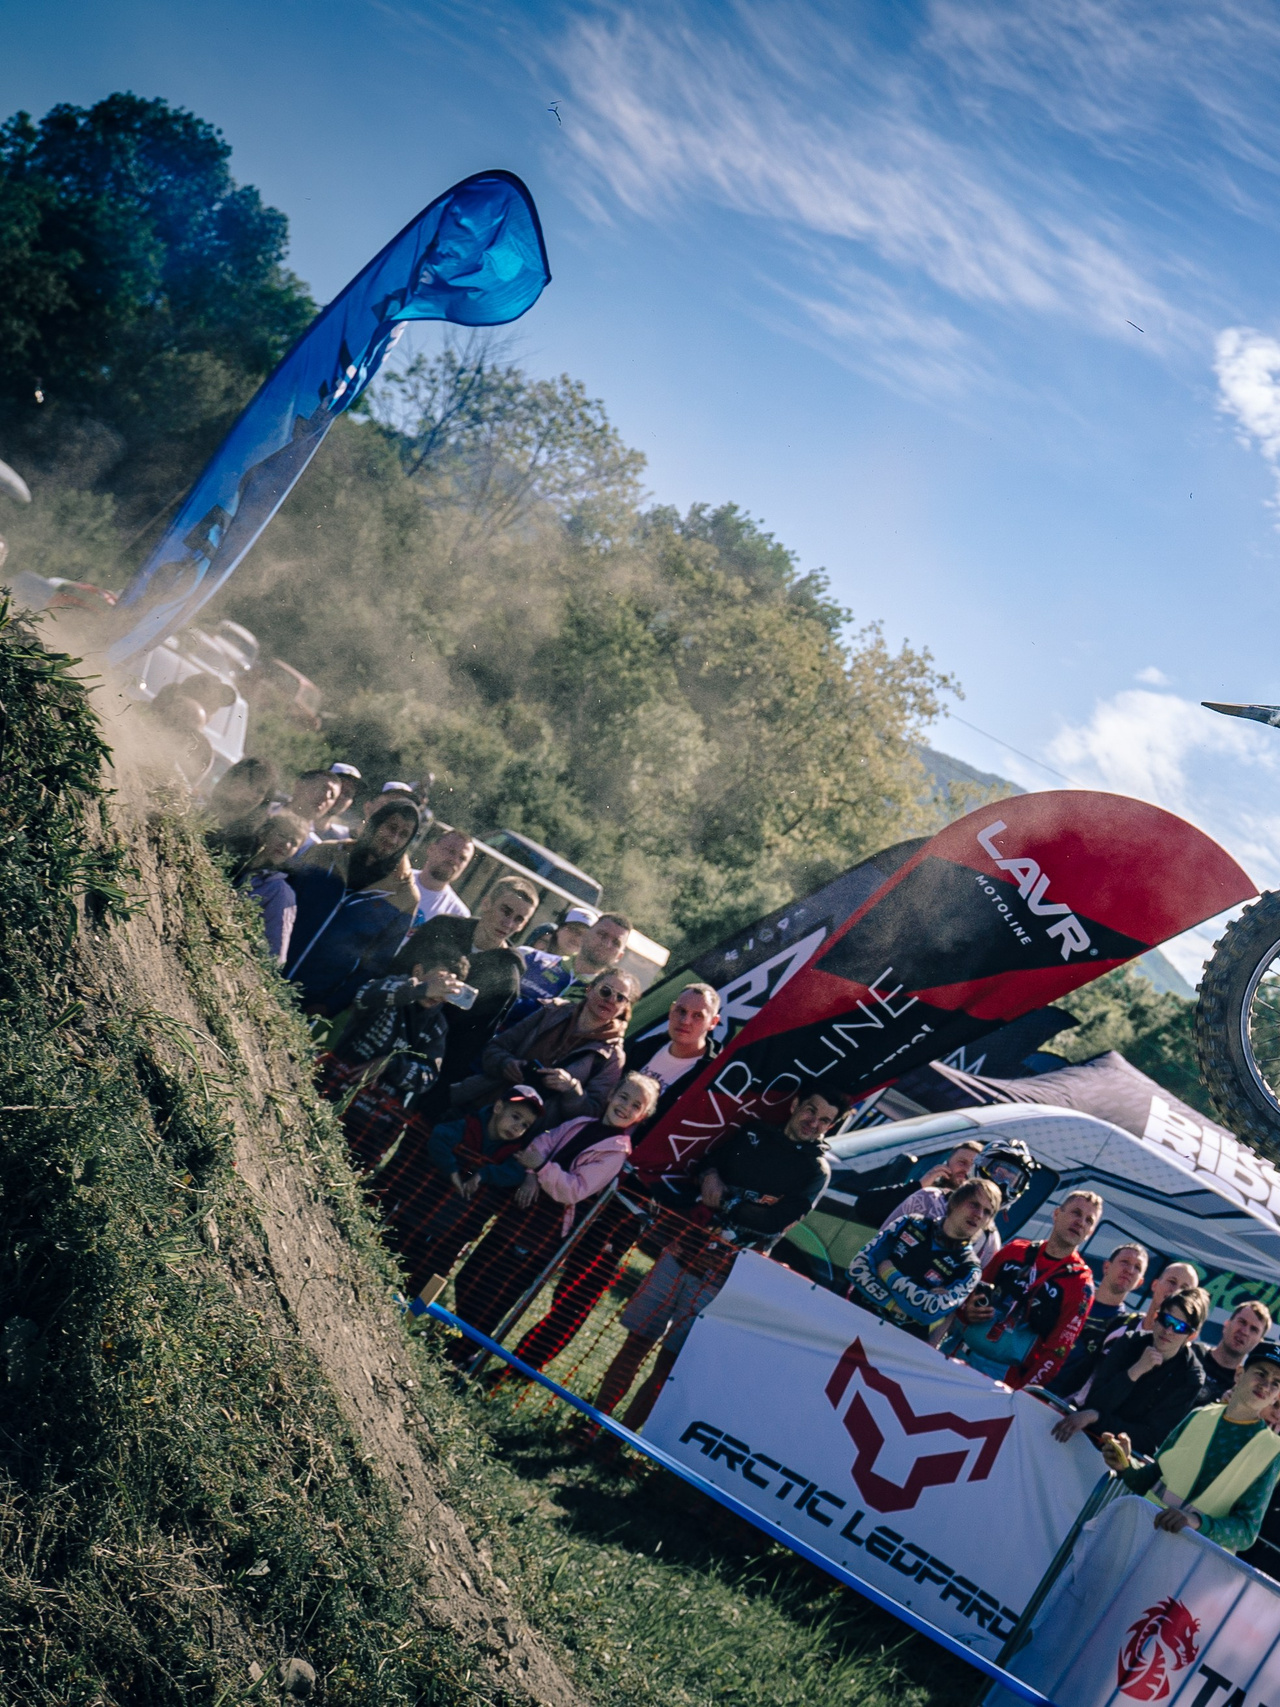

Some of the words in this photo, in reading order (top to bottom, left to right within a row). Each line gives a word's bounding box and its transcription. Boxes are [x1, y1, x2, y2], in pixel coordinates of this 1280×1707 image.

[975, 874, 1032, 945] MOTOLINE
[976, 819, 1091, 962] LAVR
[660, 1060, 753, 1168] AVR
[678, 1420, 847, 1528] ARCTIC
[839, 1509, 1021, 1642] LEOPARD
